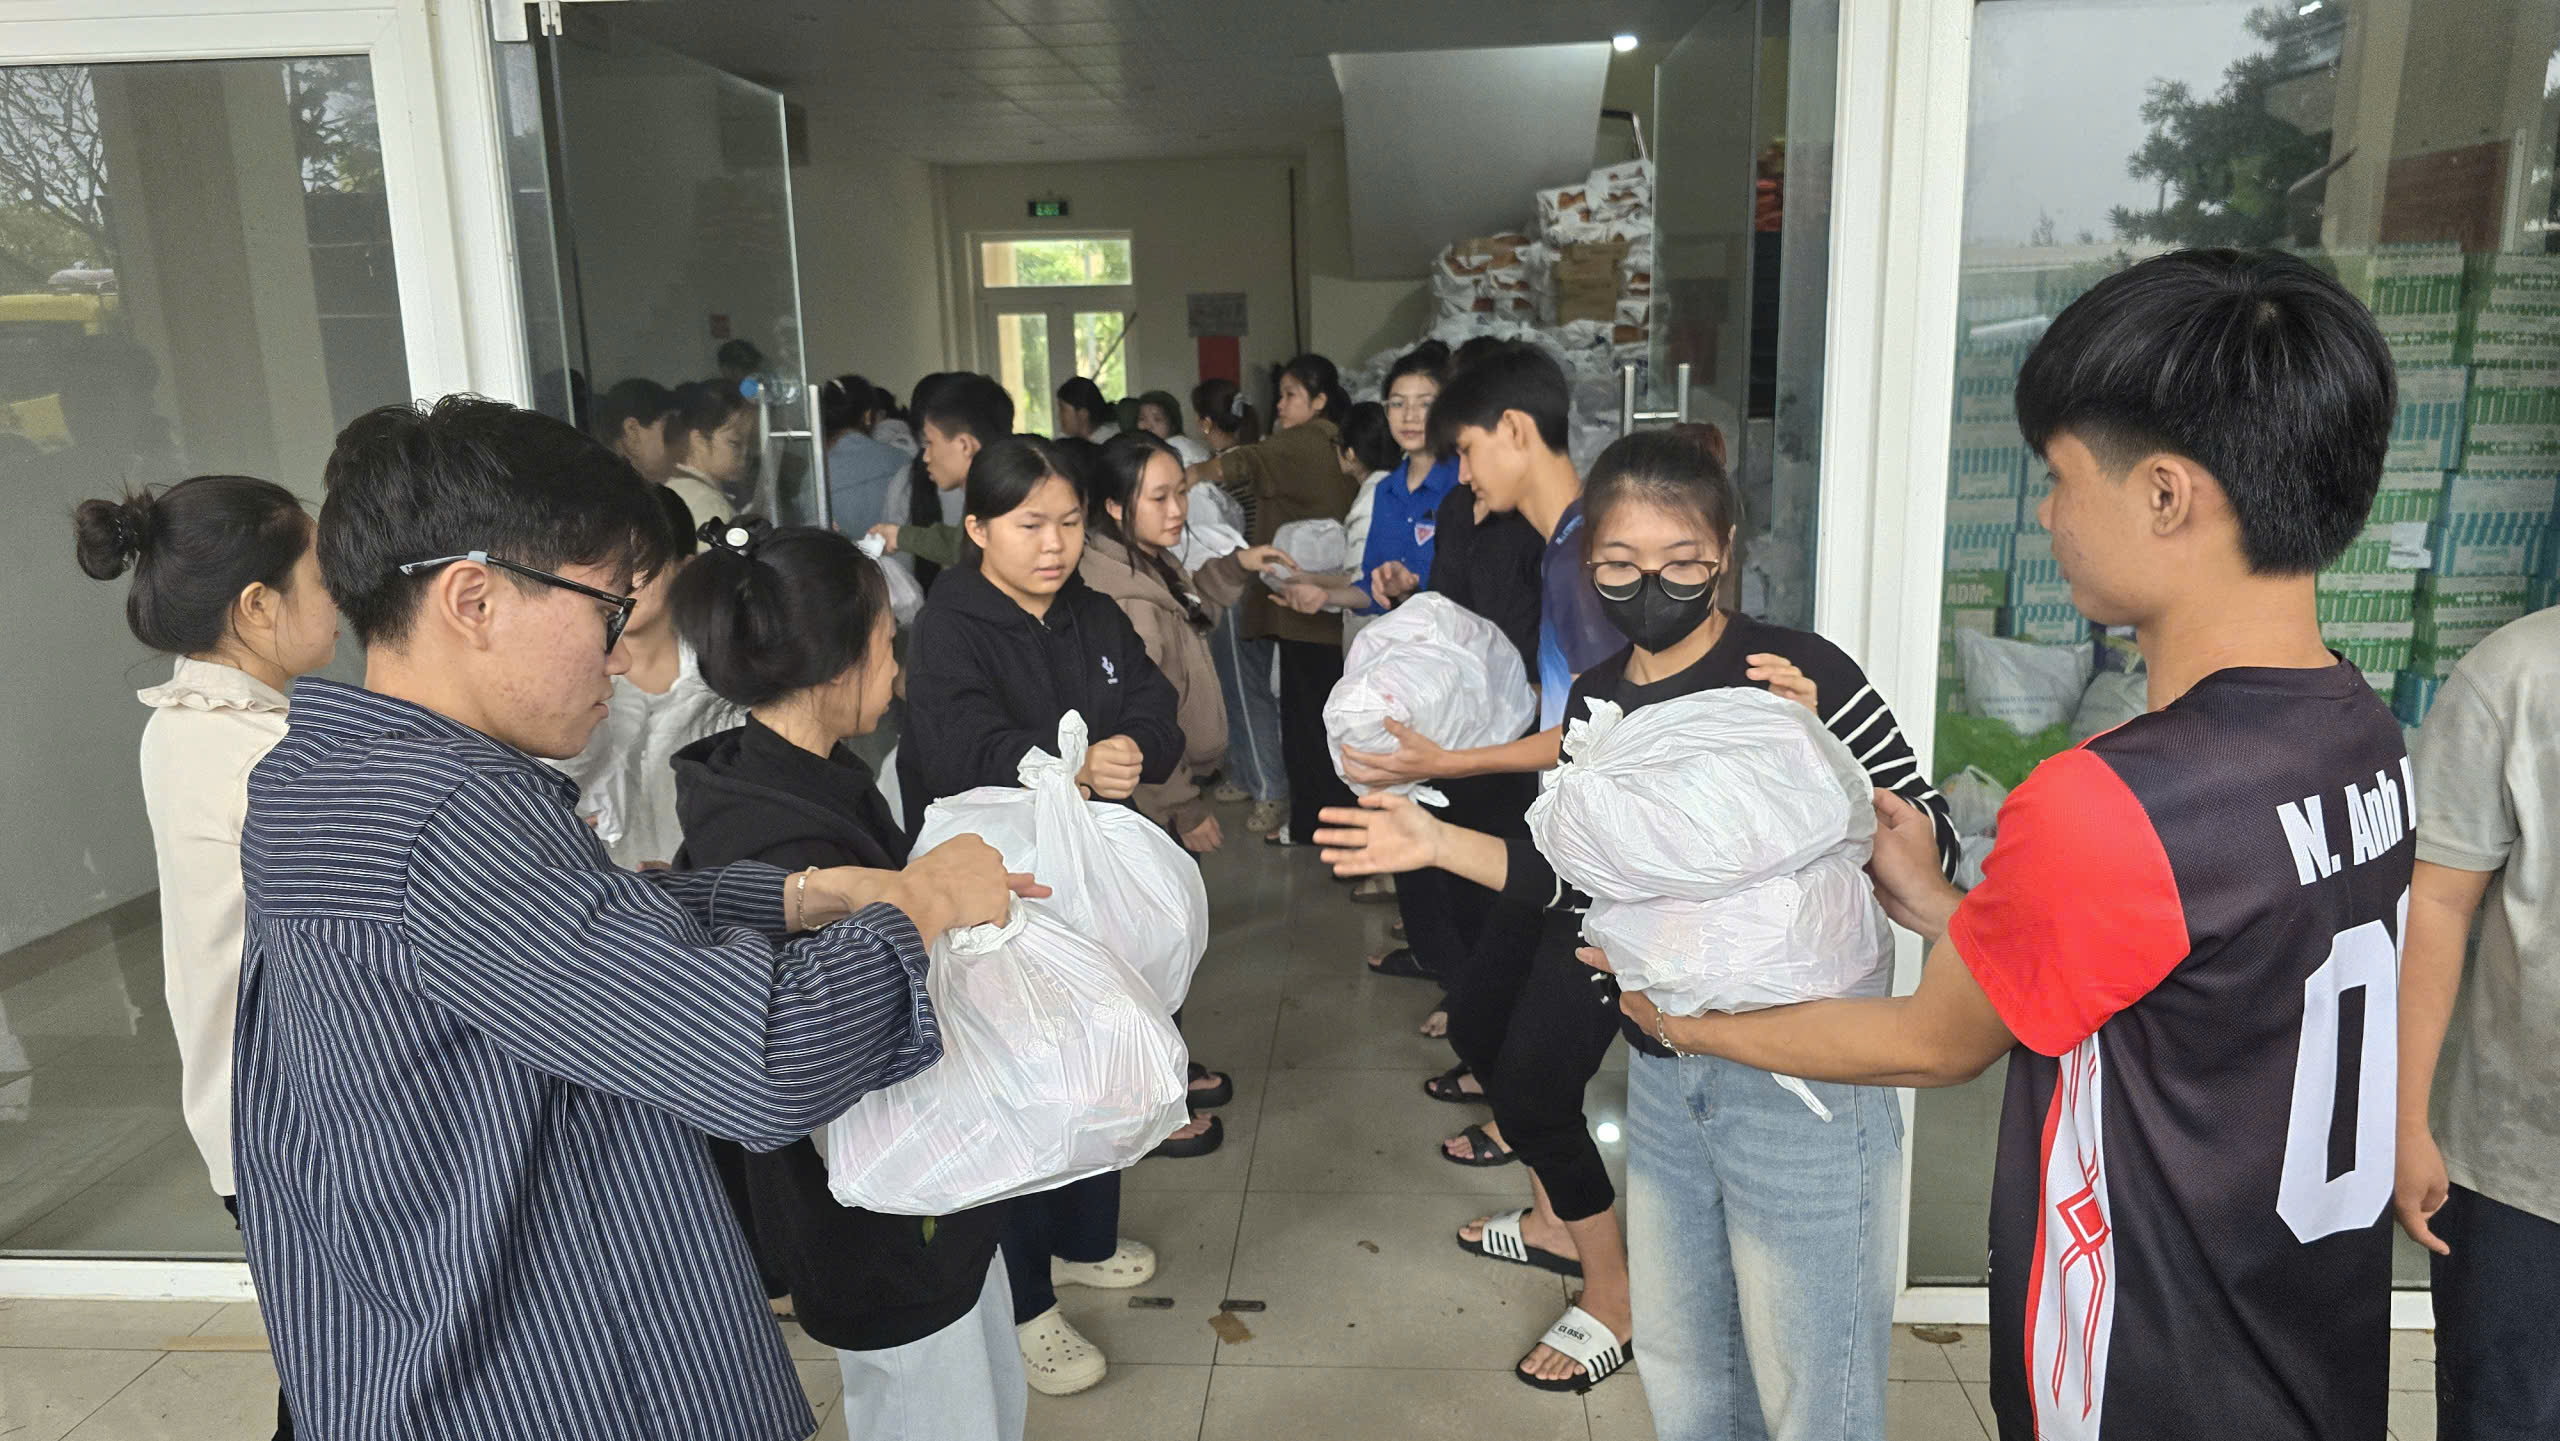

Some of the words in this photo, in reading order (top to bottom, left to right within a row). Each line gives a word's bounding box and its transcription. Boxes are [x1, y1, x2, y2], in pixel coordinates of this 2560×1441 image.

[2276, 794, 2342, 886] N.
[2344, 769, 2403, 866] Anh
[2277, 885, 2409, 1244] 0
